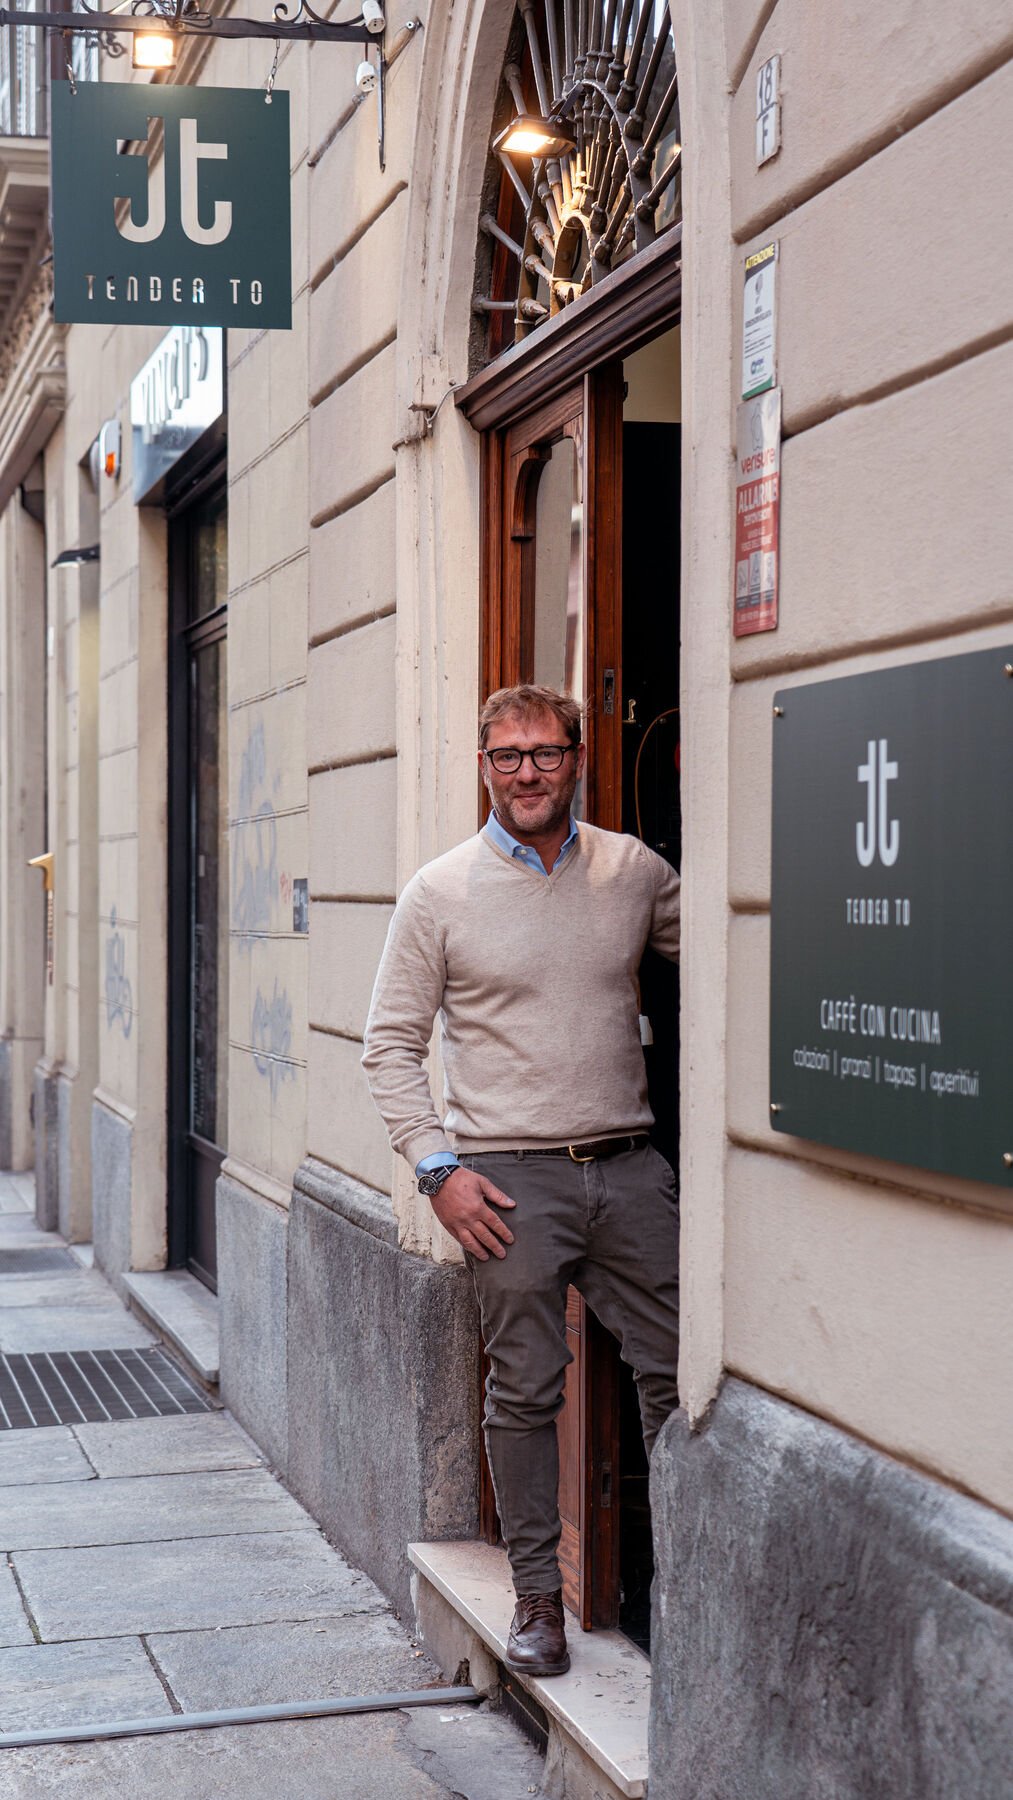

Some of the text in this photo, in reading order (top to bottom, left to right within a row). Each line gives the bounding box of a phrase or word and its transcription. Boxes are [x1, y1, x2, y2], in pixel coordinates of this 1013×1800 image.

[85, 274, 263, 306] TENDER TO
[741, 446, 776, 475] verisure
[846, 898, 911, 926] TENDER TO
[820, 994, 941, 1046] CAFFÈ CON CUCINA
[793, 1045, 831, 1071] colazioni
[840, 1055, 872, 1080] pranzi
[883, 1060, 916, 1090] tapas
[929, 1068, 980, 1097] aperitivi
